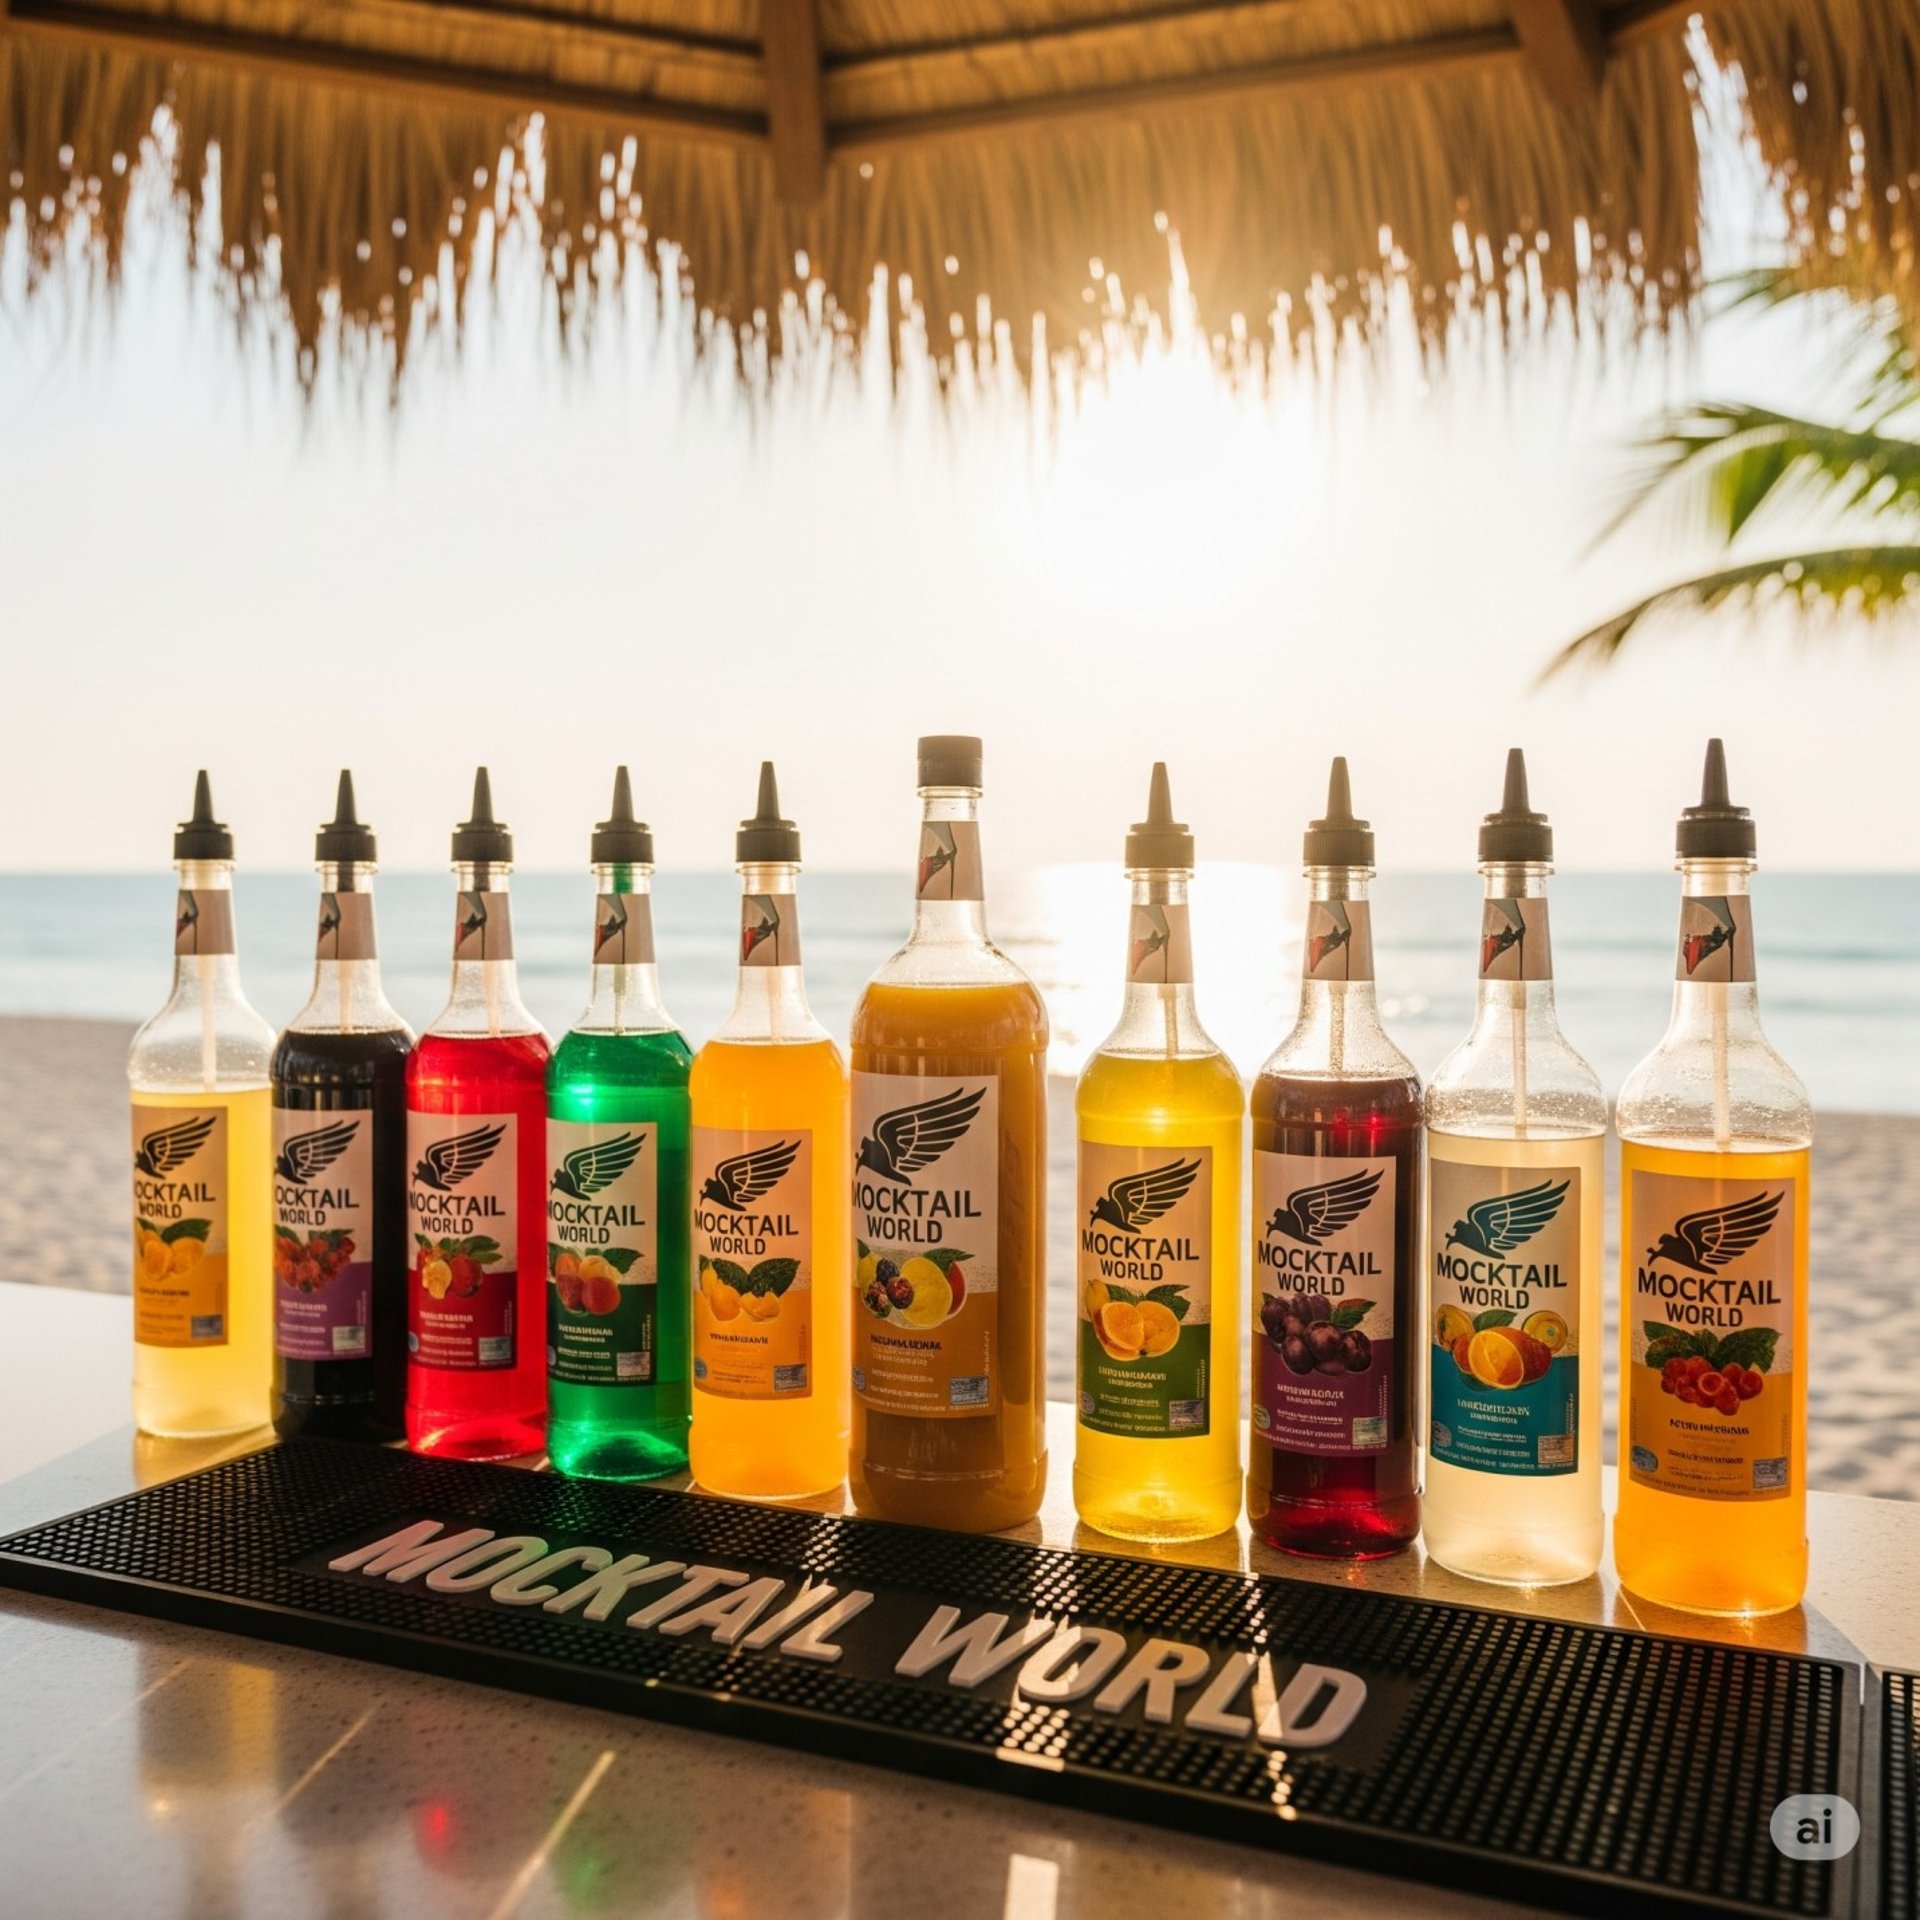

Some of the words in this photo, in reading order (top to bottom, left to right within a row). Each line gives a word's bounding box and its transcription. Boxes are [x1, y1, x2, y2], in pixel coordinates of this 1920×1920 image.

[138, 1201, 182, 1219] WORLD
[279, 1207, 326, 1226] WORLD
[694, 1208, 799, 1237] MOCKTAIL
[421, 1216, 473, 1235] WORLD
[557, 1224, 610, 1245] WORLD
[866, 1214, 942, 1244] WORLD
[709, 1235, 766, 1255] WORLD
[1081, 1229, 1200, 1261] MOCKTAIL
[1257, 1240, 1382, 1276] MOCKTAIL
[1099, 1258, 1164, 1282] WORLD
[1436, 1252, 1568, 1289] MOCKTAIL
[1277, 1271, 1345, 1296] WORLD
[1637, 1267, 1782, 1306] MOCKTAIL
[1459, 1284, 1531, 1310] WORLD
[1665, 1301, 1743, 1328] WORLD
[328, 1519, 875, 1663] MOCKTAIL
[894, 1604, 1368, 1749] WORLD
